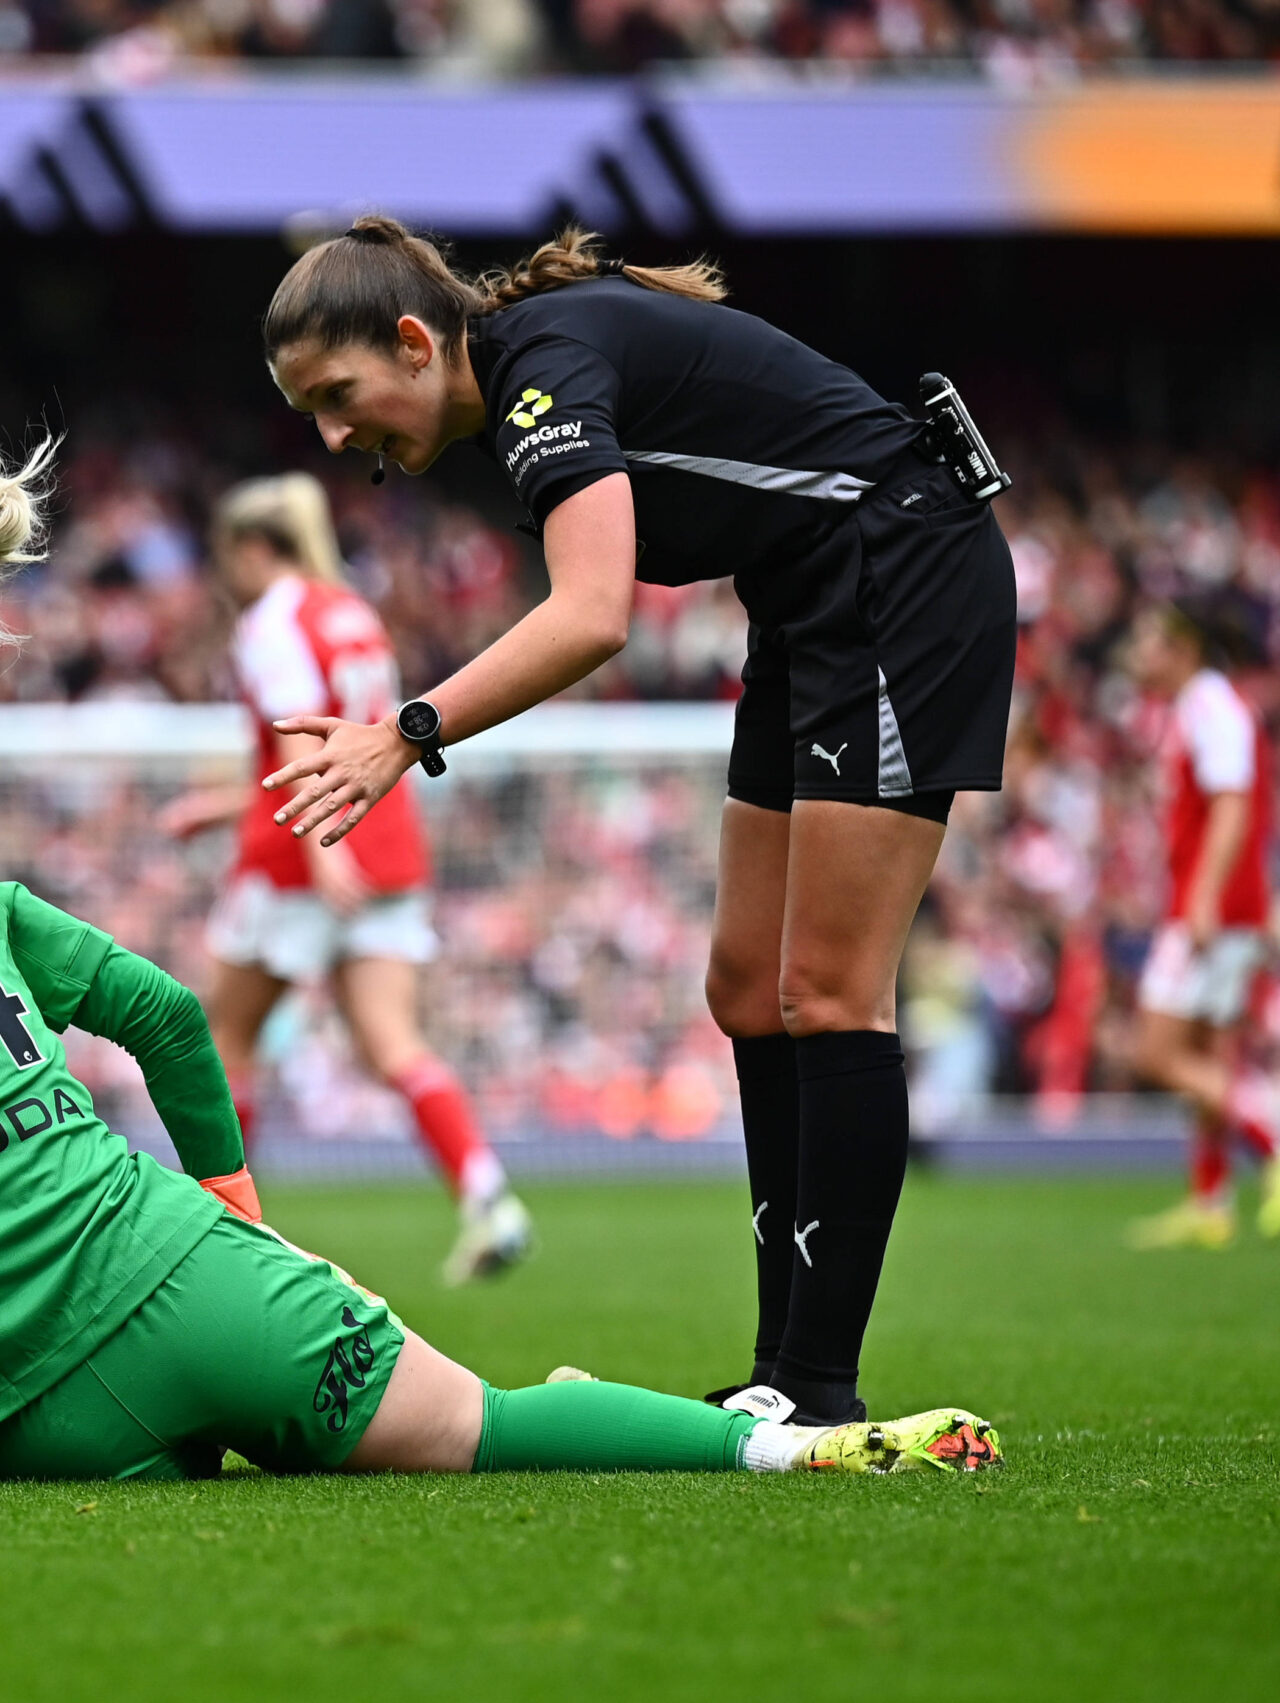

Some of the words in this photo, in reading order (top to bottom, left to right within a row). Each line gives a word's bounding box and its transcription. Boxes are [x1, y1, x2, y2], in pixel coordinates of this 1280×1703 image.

[506, 420, 582, 472] HuwsGray
[540, 439, 590, 457] Supplies
[748, 1393, 775, 1409] PUMA
